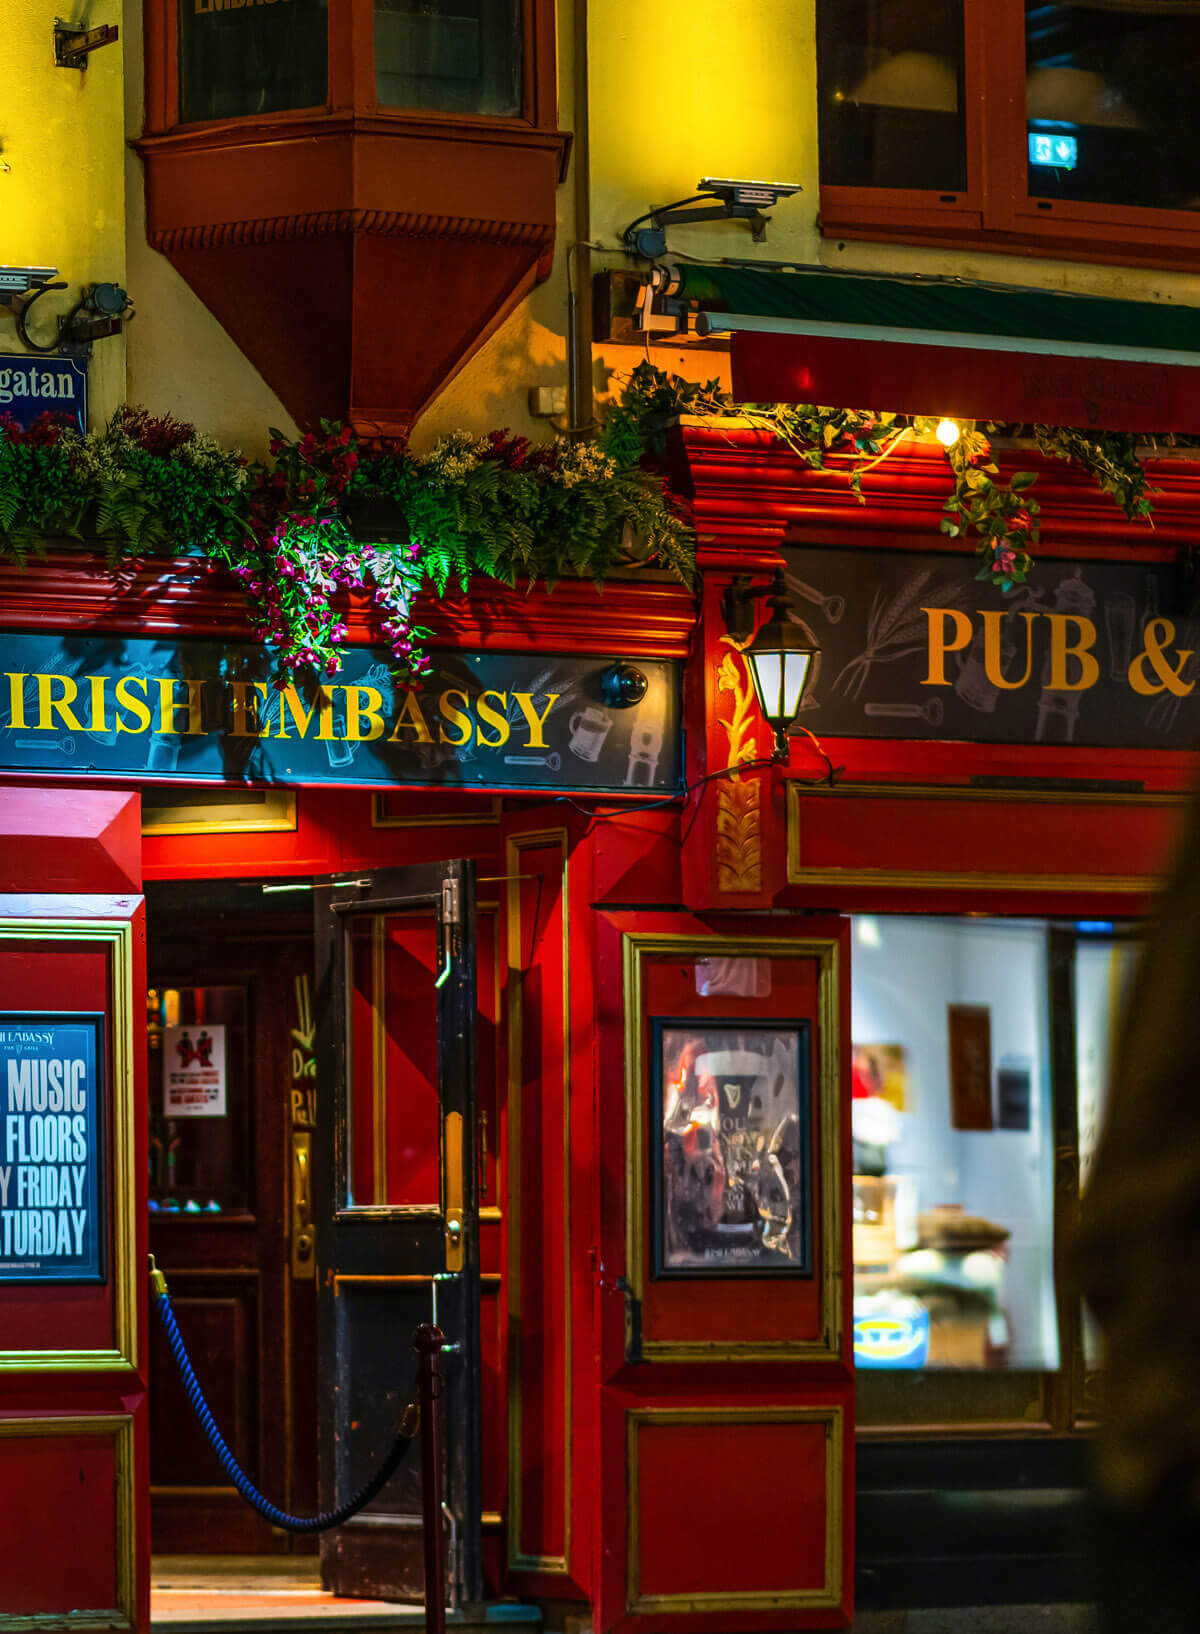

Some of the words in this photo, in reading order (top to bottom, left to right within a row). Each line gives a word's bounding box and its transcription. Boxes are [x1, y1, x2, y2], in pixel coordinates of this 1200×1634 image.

[919, 607, 1100, 690] PUB
[1127, 617, 1198, 697] &
[3, 672, 208, 735] IRISH
[226, 680, 560, 748] EMBASSY
[7, 1059, 86, 1112] MUSIC
[6, 1115, 87, 1162] FLOORS
[17, 1166, 87, 1207] FRIDAY
